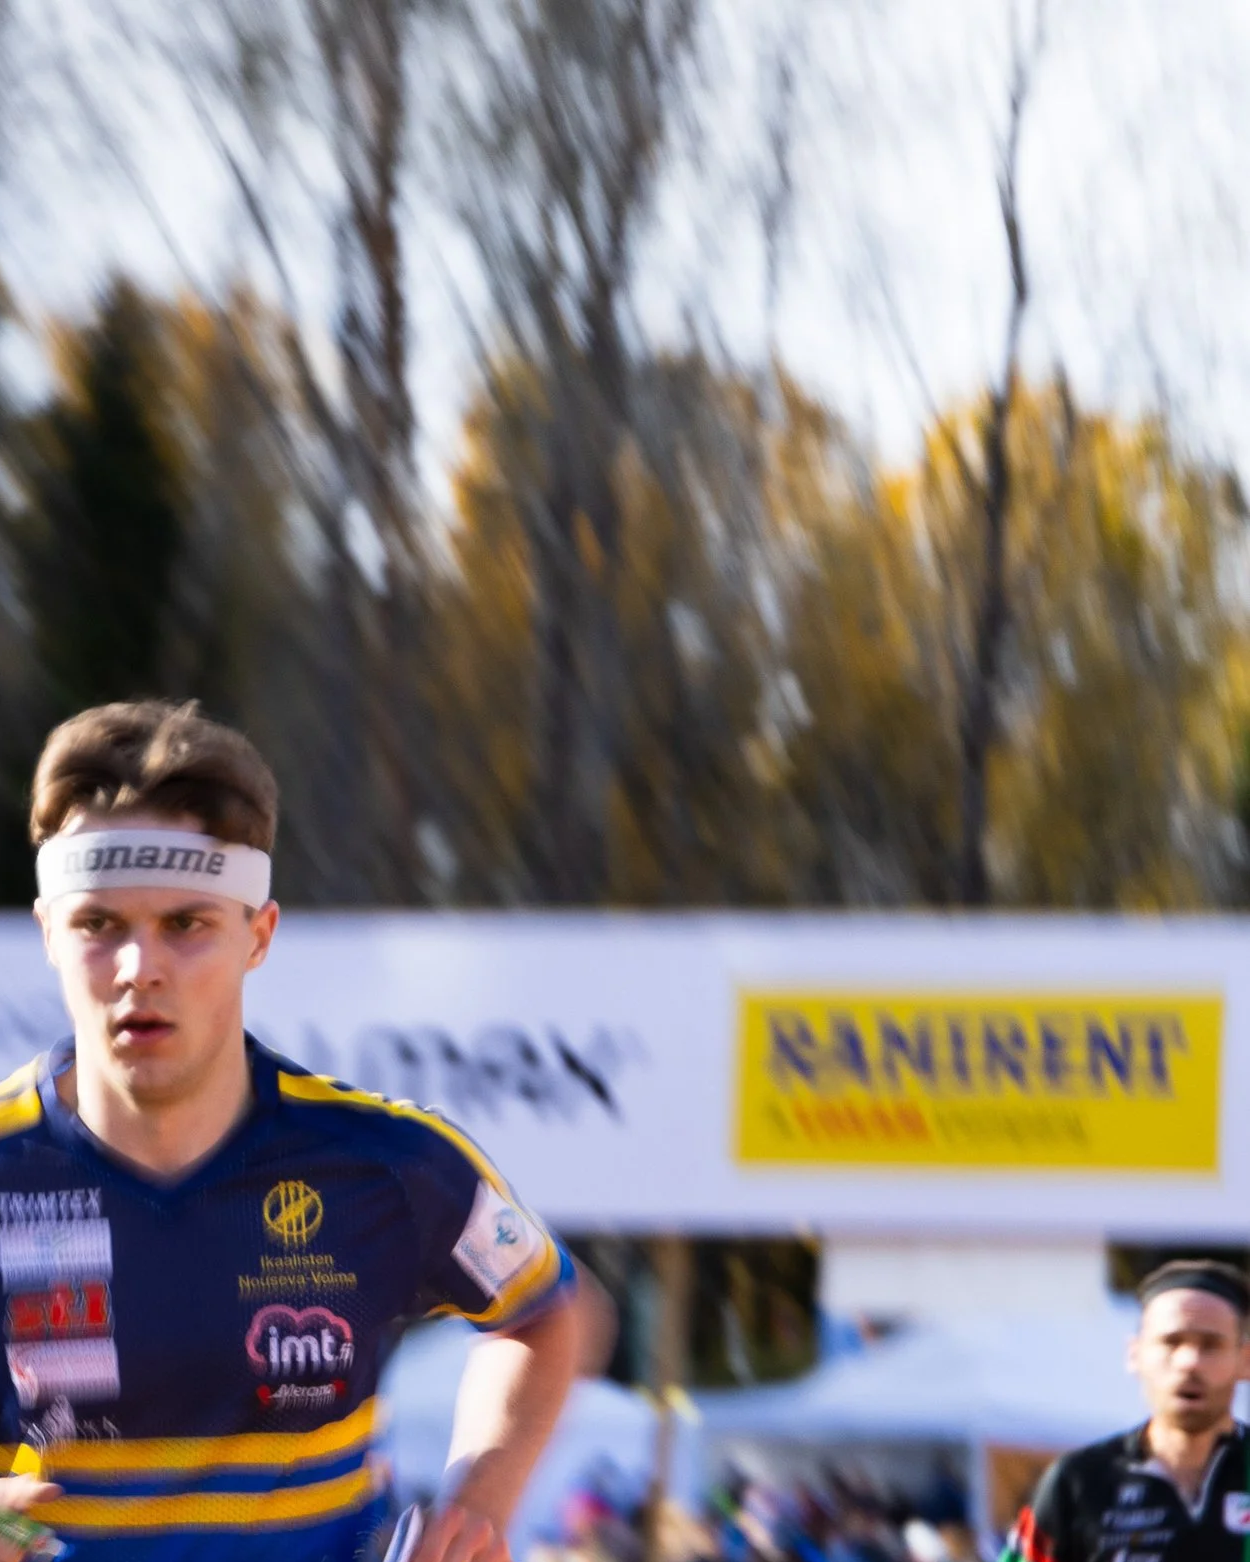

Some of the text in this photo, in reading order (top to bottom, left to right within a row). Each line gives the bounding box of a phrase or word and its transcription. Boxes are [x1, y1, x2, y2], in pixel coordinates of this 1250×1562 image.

[64, 845, 226, 875] noname
[259, 1253, 334, 1271] Ikaalisten
[237, 1271, 358, 1292] Nouseva-Voima
